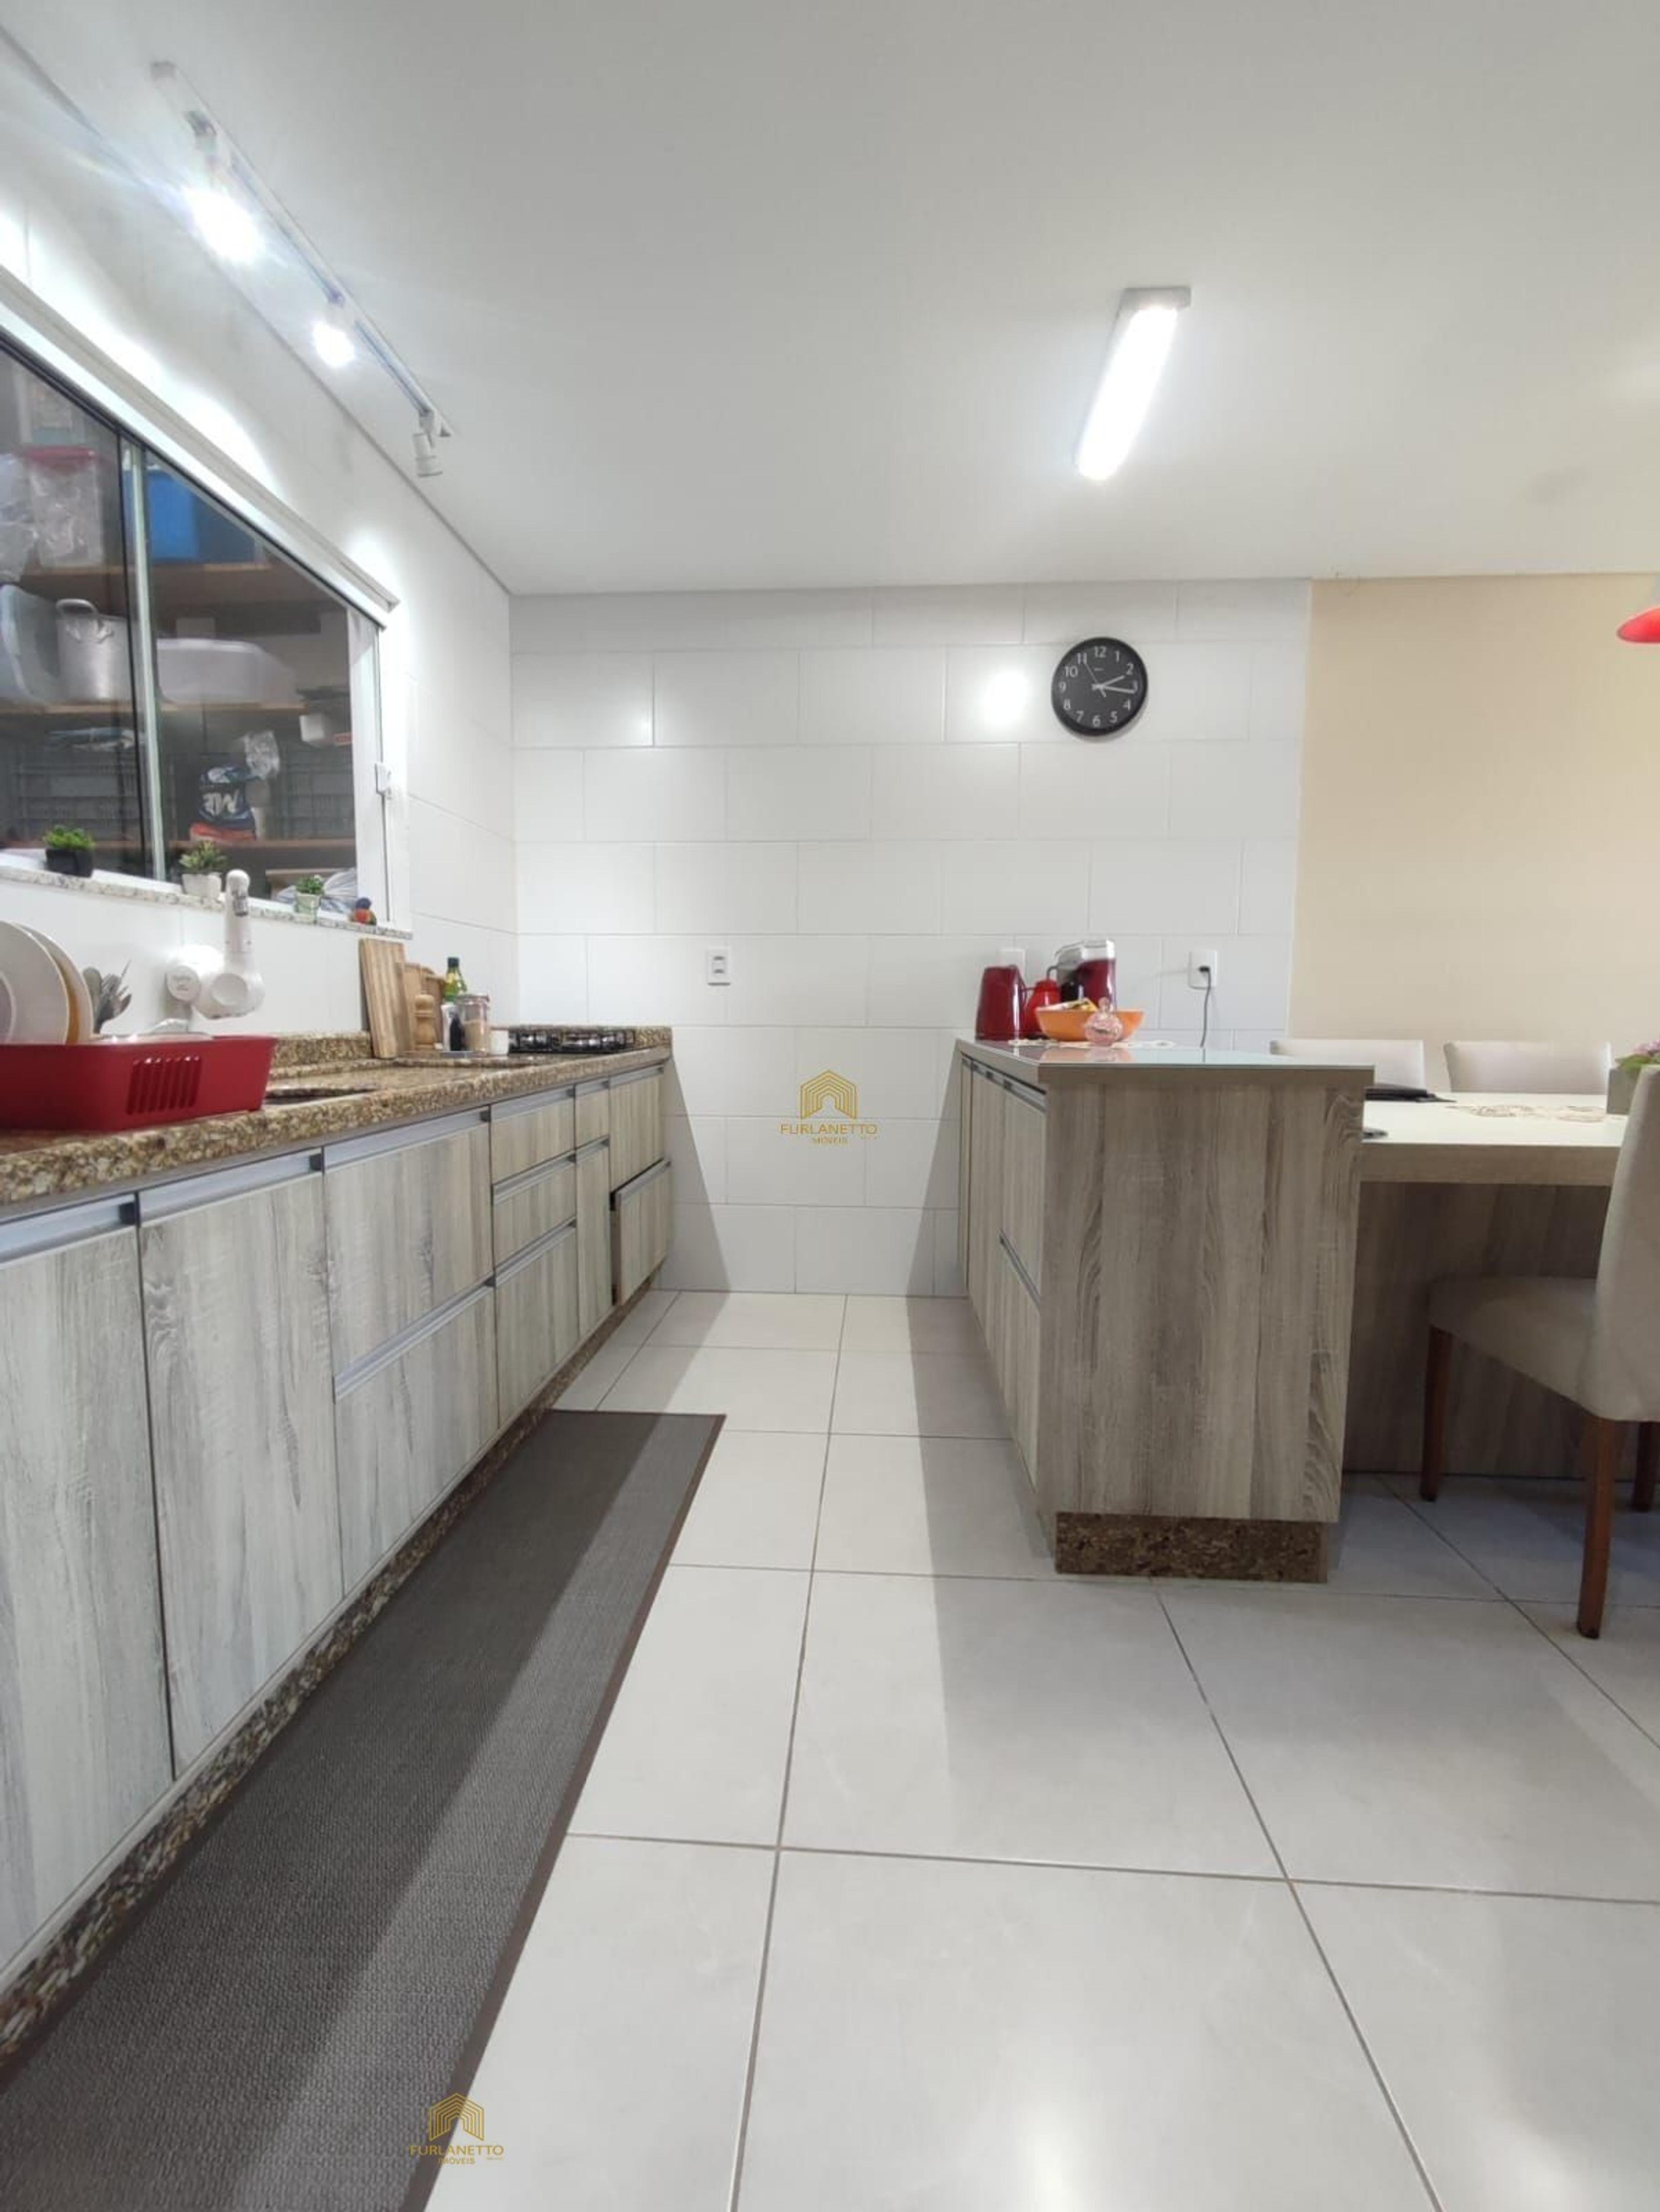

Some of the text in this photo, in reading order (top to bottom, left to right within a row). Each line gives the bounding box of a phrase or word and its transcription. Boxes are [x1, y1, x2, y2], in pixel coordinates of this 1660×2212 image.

[1077, 652, 1087, 664] 11
[1094, 646, 1106, 658] 12
[1114, 650, 1120, 662] 1
[1065, 665, 1078, 678] 10
[1126, 662, 1134, 675] 2
[1059, 682, 1066, 692] 9
[1063, 699, 1071, 710] 8
[1123, 699, 1131, 711] 4
[1076, 710, 1084, 723] 7
[1092, 715, 1101, 727] 6
[1109, 711, 1118, 723] 5
